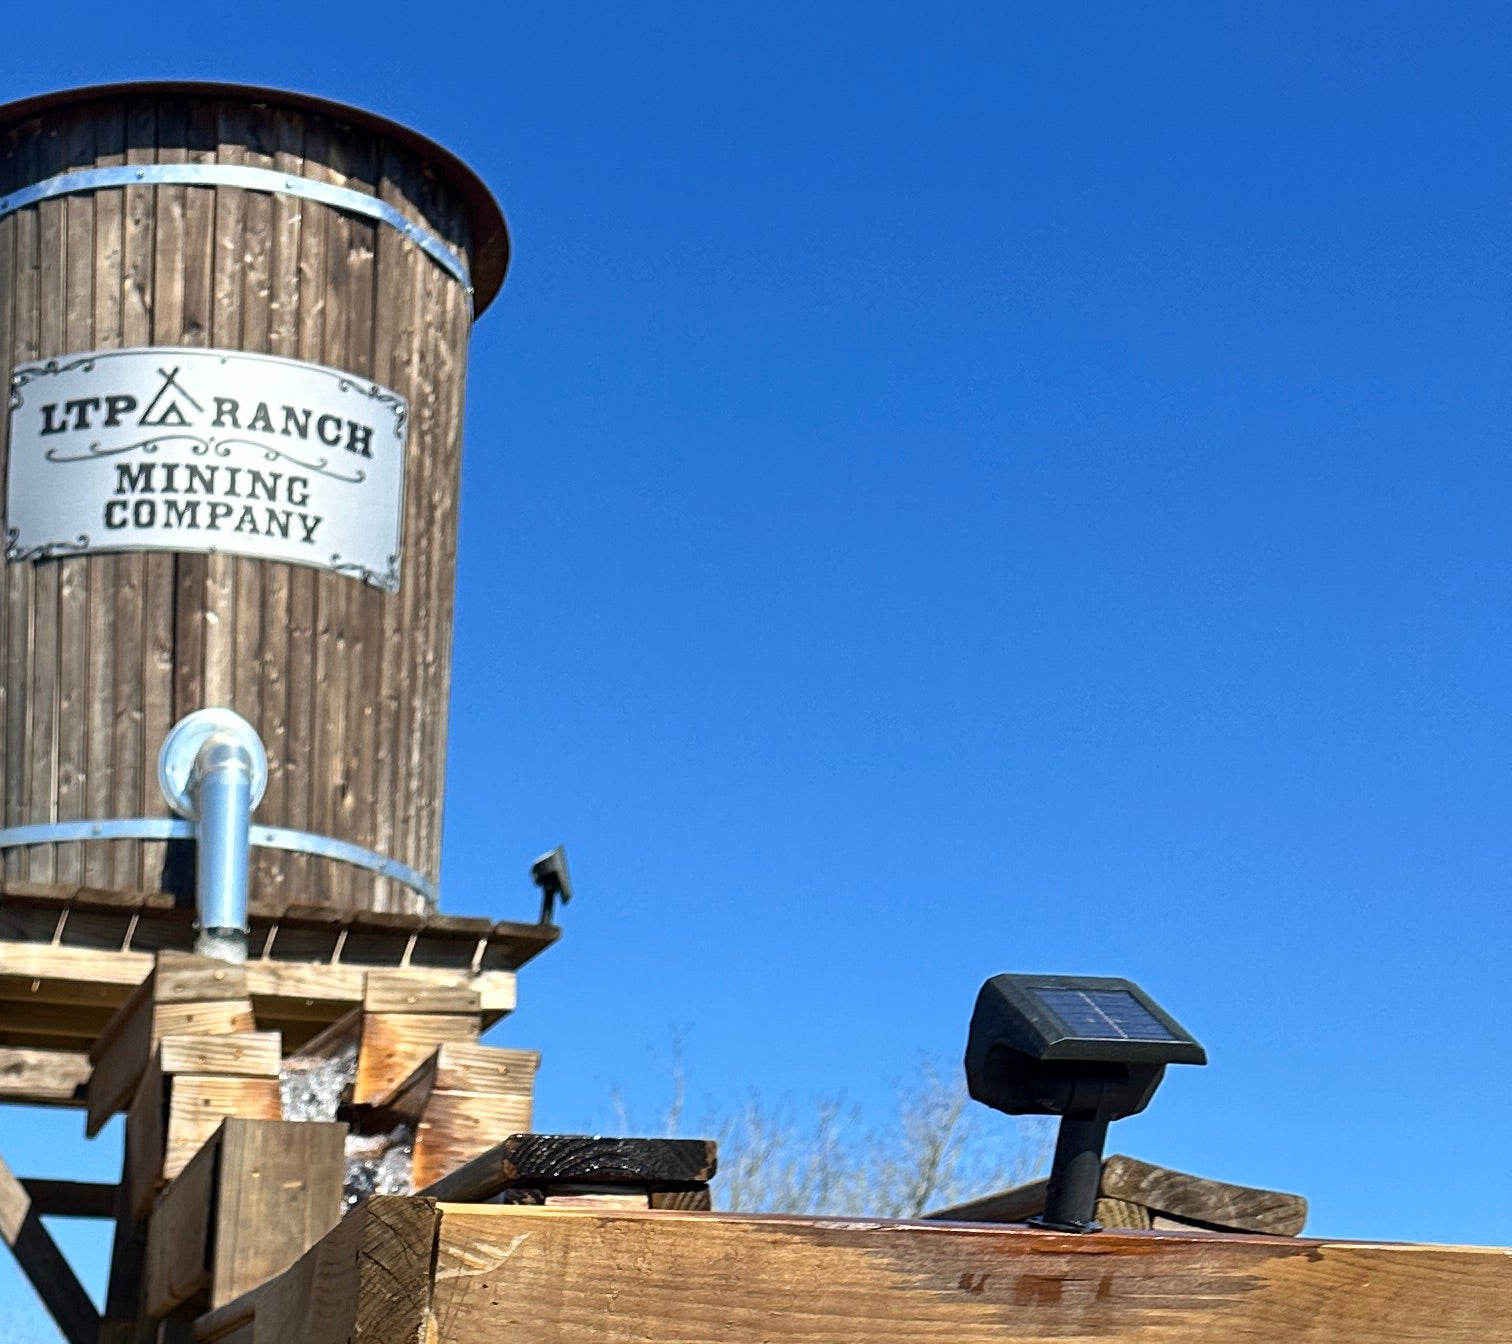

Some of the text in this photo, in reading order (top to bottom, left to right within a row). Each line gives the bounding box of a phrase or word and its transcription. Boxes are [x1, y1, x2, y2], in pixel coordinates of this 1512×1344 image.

[39, 394, 375, 460] LTP RANCH
[114, 462, 311, 508] MINING
[103, 498, 323, 545] COMPANY
